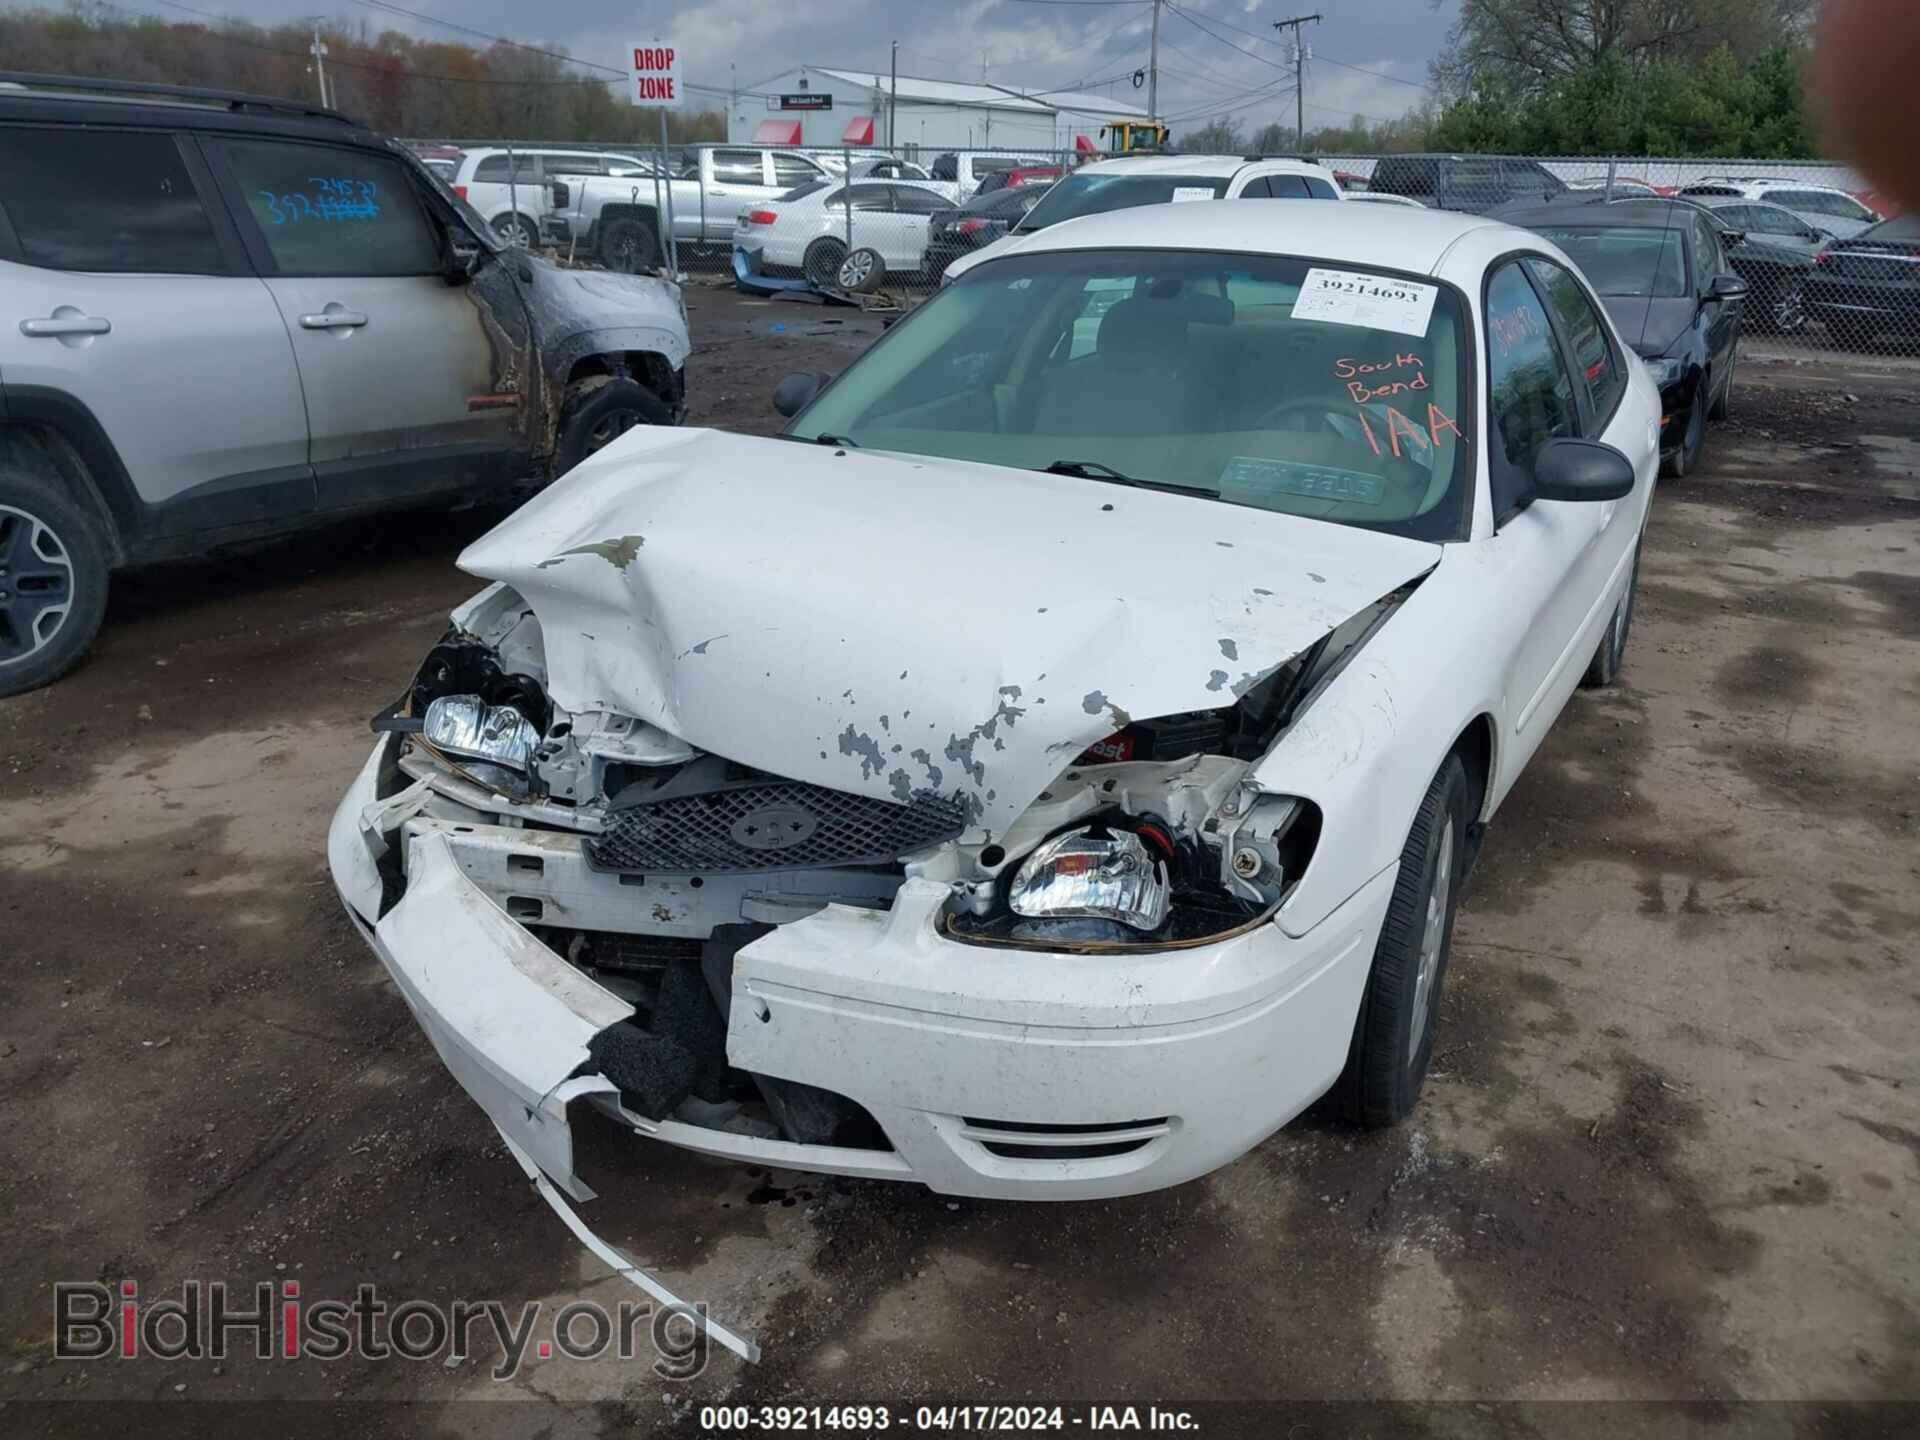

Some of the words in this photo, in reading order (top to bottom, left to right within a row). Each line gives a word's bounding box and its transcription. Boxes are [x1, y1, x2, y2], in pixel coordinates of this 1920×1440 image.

[634, 47, 674, 71] DROP
[638, 77, 675, 99] ZONE
[1316, 279, 1419, 303] 39214693
[1335, 353, 1424, 378] South
[1347, 371, 1429, 403] Bend
